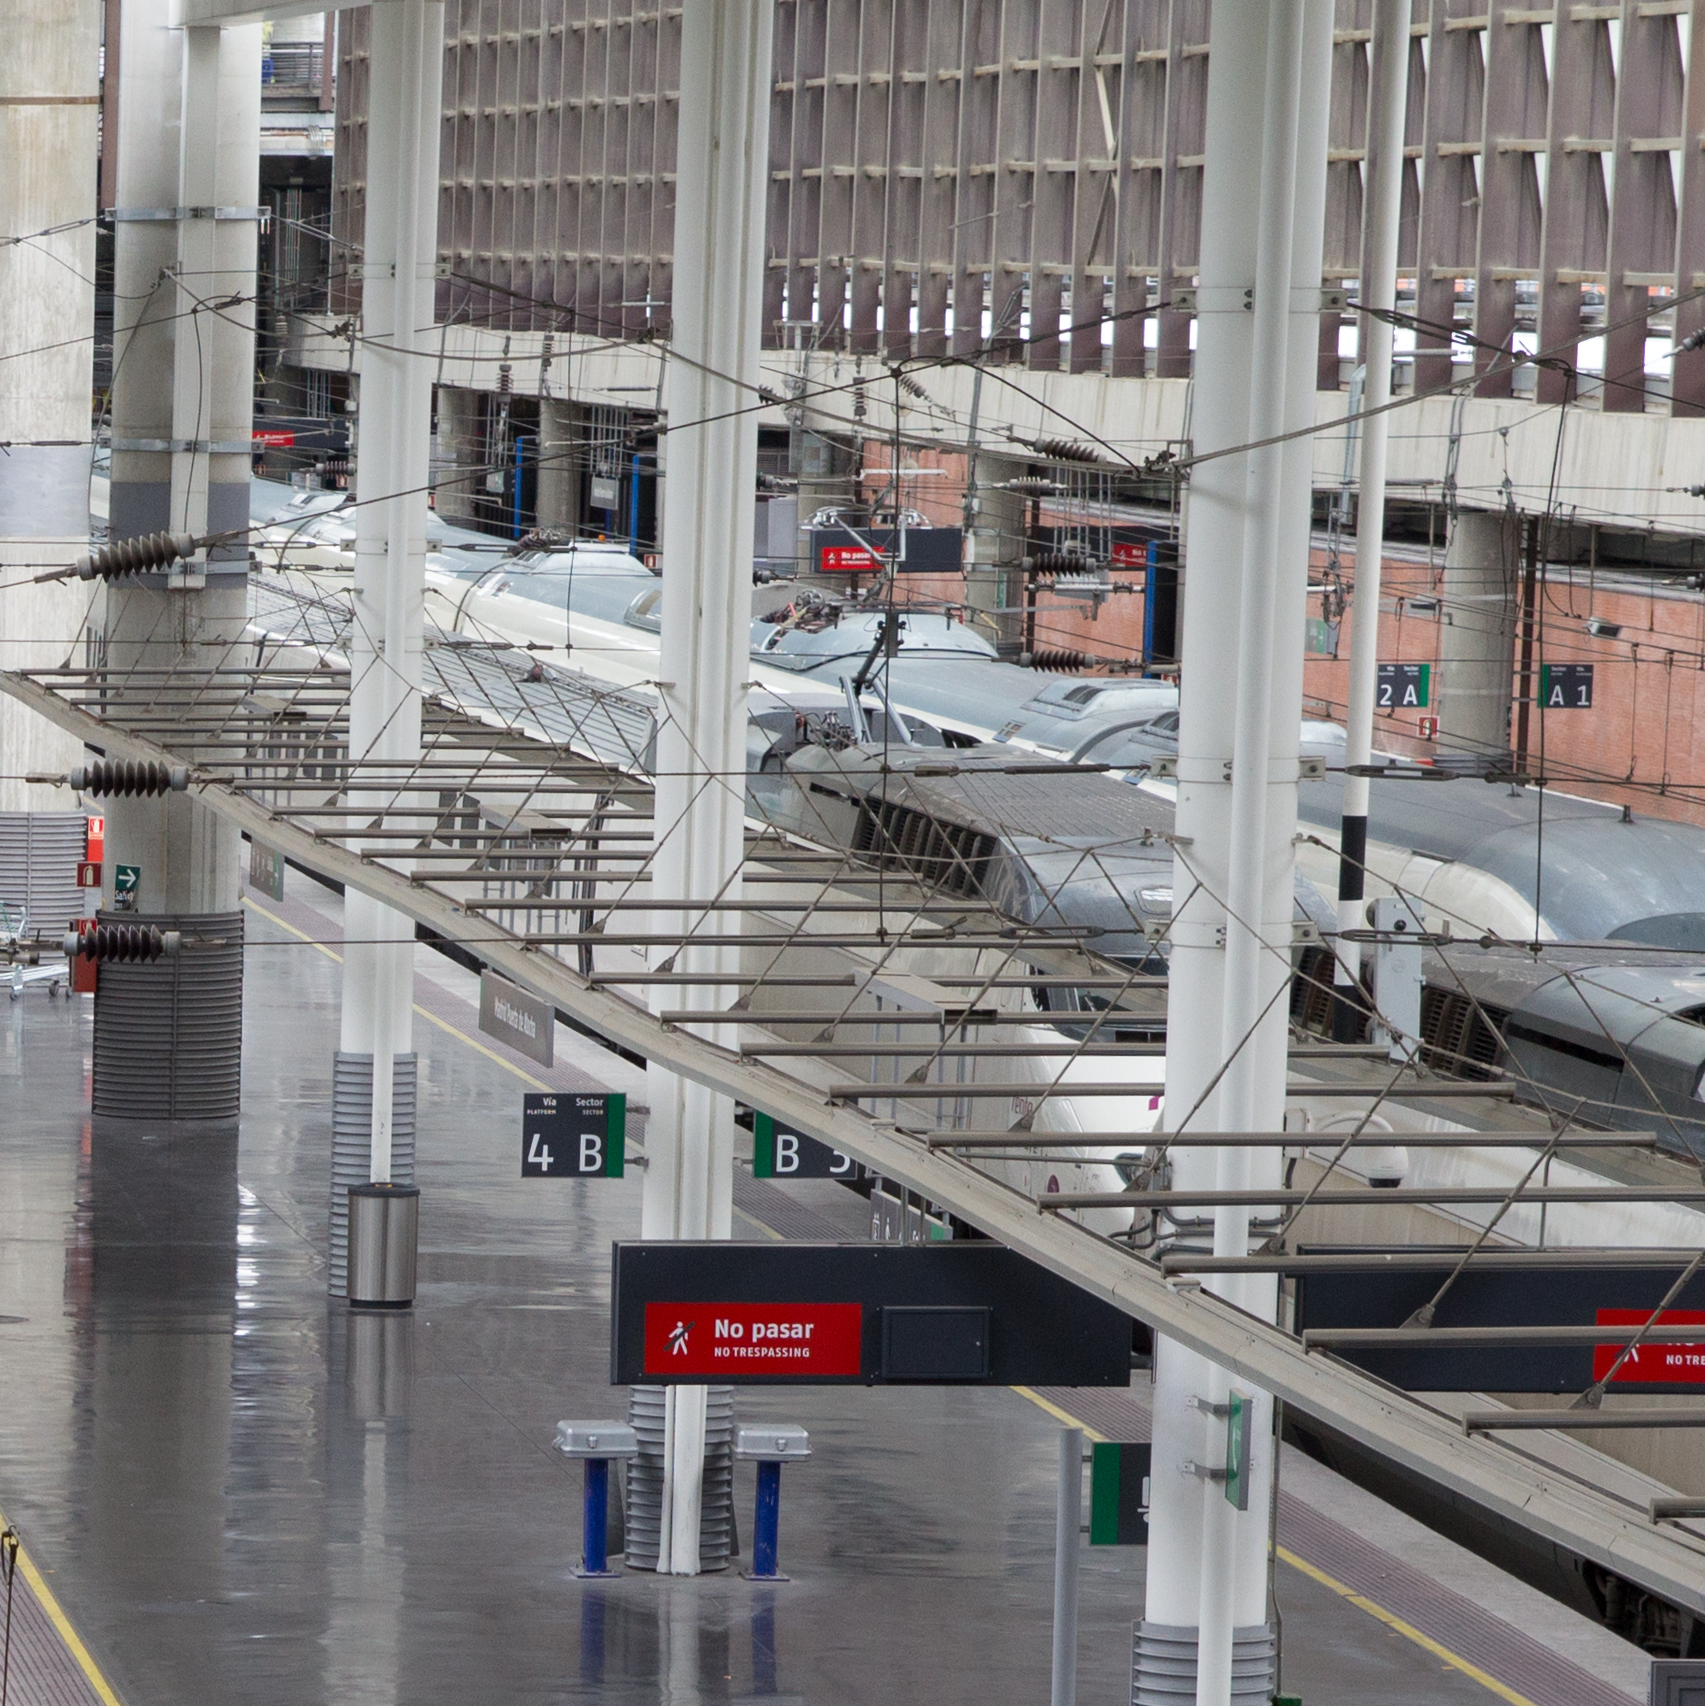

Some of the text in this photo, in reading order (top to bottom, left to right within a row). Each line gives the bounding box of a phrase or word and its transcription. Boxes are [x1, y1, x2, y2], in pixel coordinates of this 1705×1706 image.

[1380, 684, 1418, 705] 2 A
[1549, 685, 1590, 705] A 1
[576, 1098, 604, 1106] Sector
[527, 1133, 602, 1171] 4 B
[776, 1134, 799, 1172] B
[715, 1319, 814, 1342] No pasar
[714, 1347, 810, 1358] NO TRESPASSING
[1666, 1355, 1682, 1365] NO
